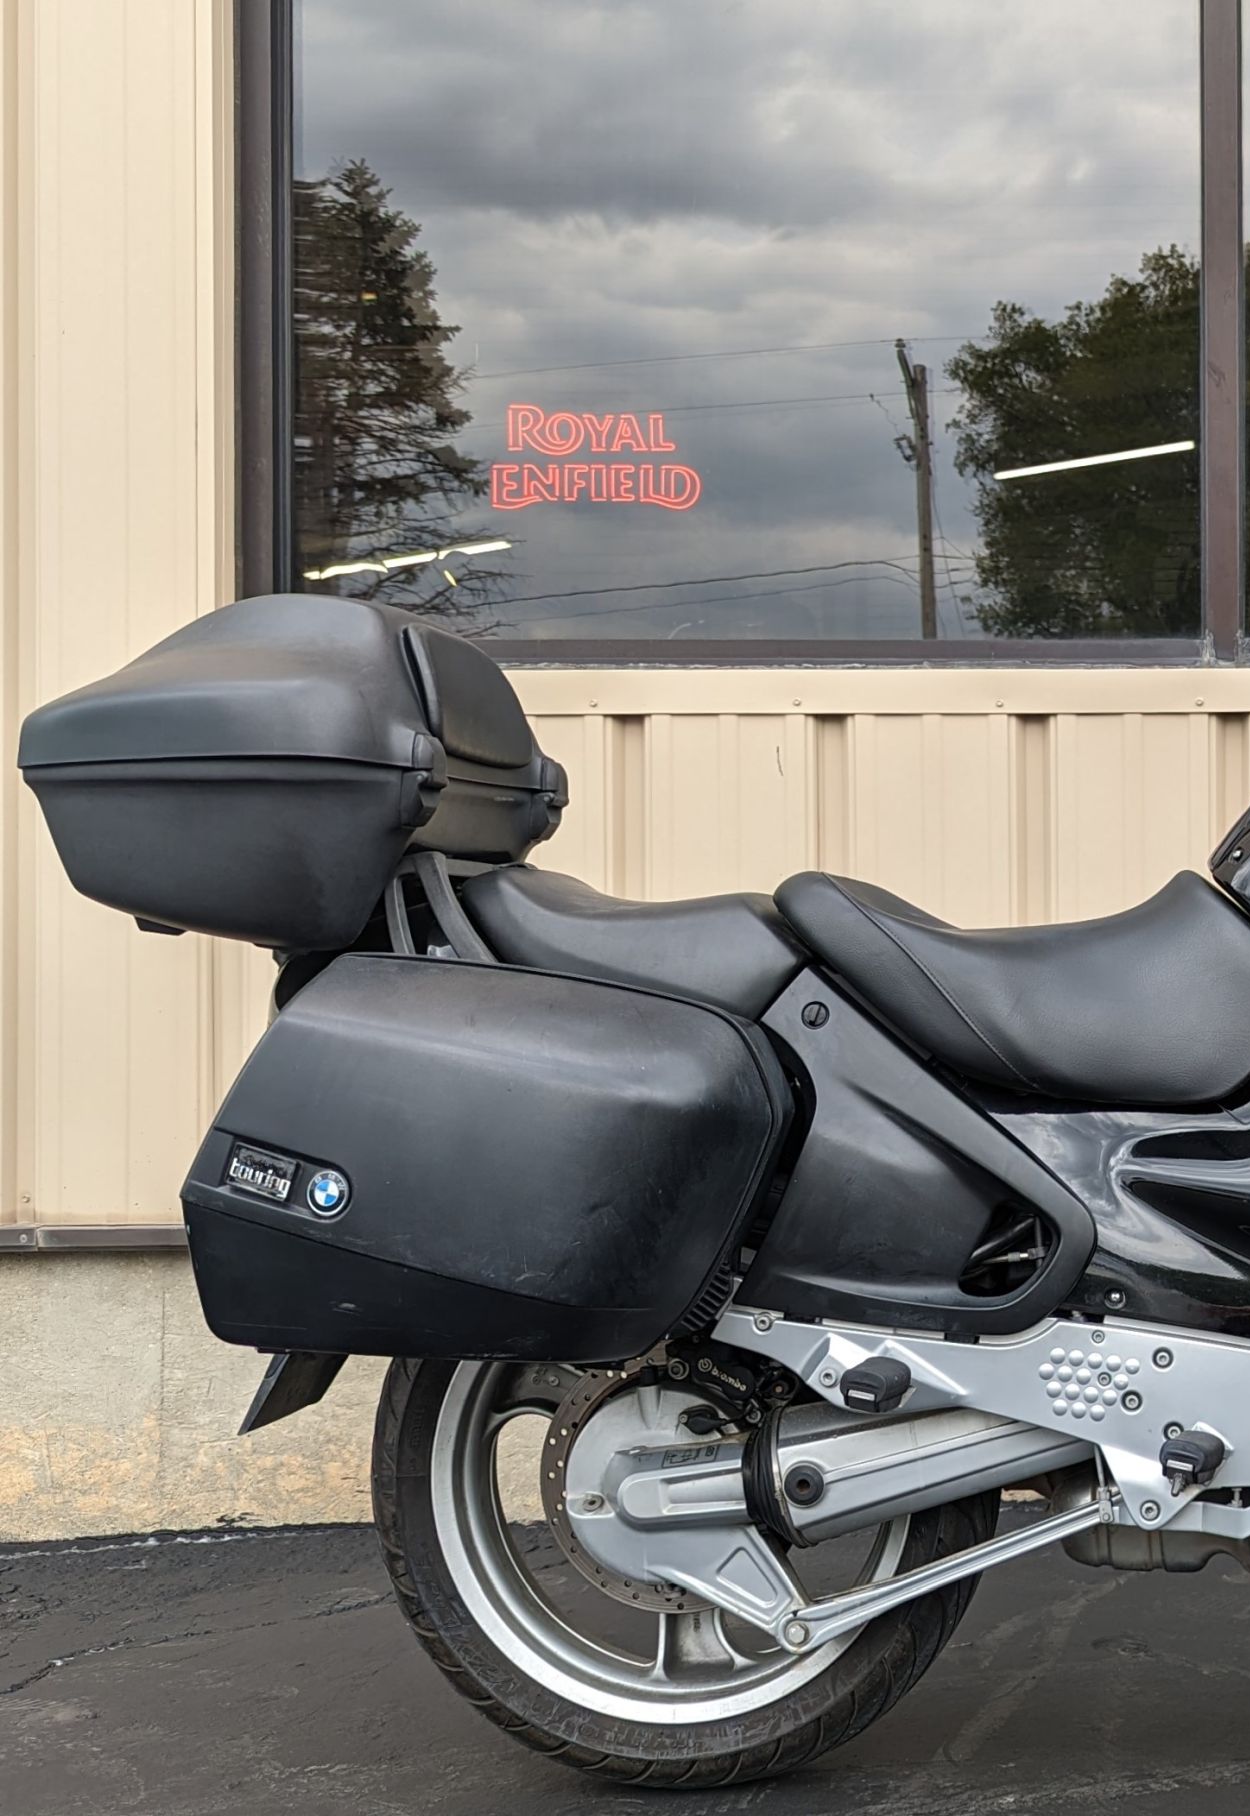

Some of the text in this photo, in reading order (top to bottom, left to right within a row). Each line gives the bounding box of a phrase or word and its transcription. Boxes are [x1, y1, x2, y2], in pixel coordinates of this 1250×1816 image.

[507, 404, 677, 456] ROYAL
[491, 464, 701, 510] ENFIELD
[229, 1157, 291, 1198] touring
